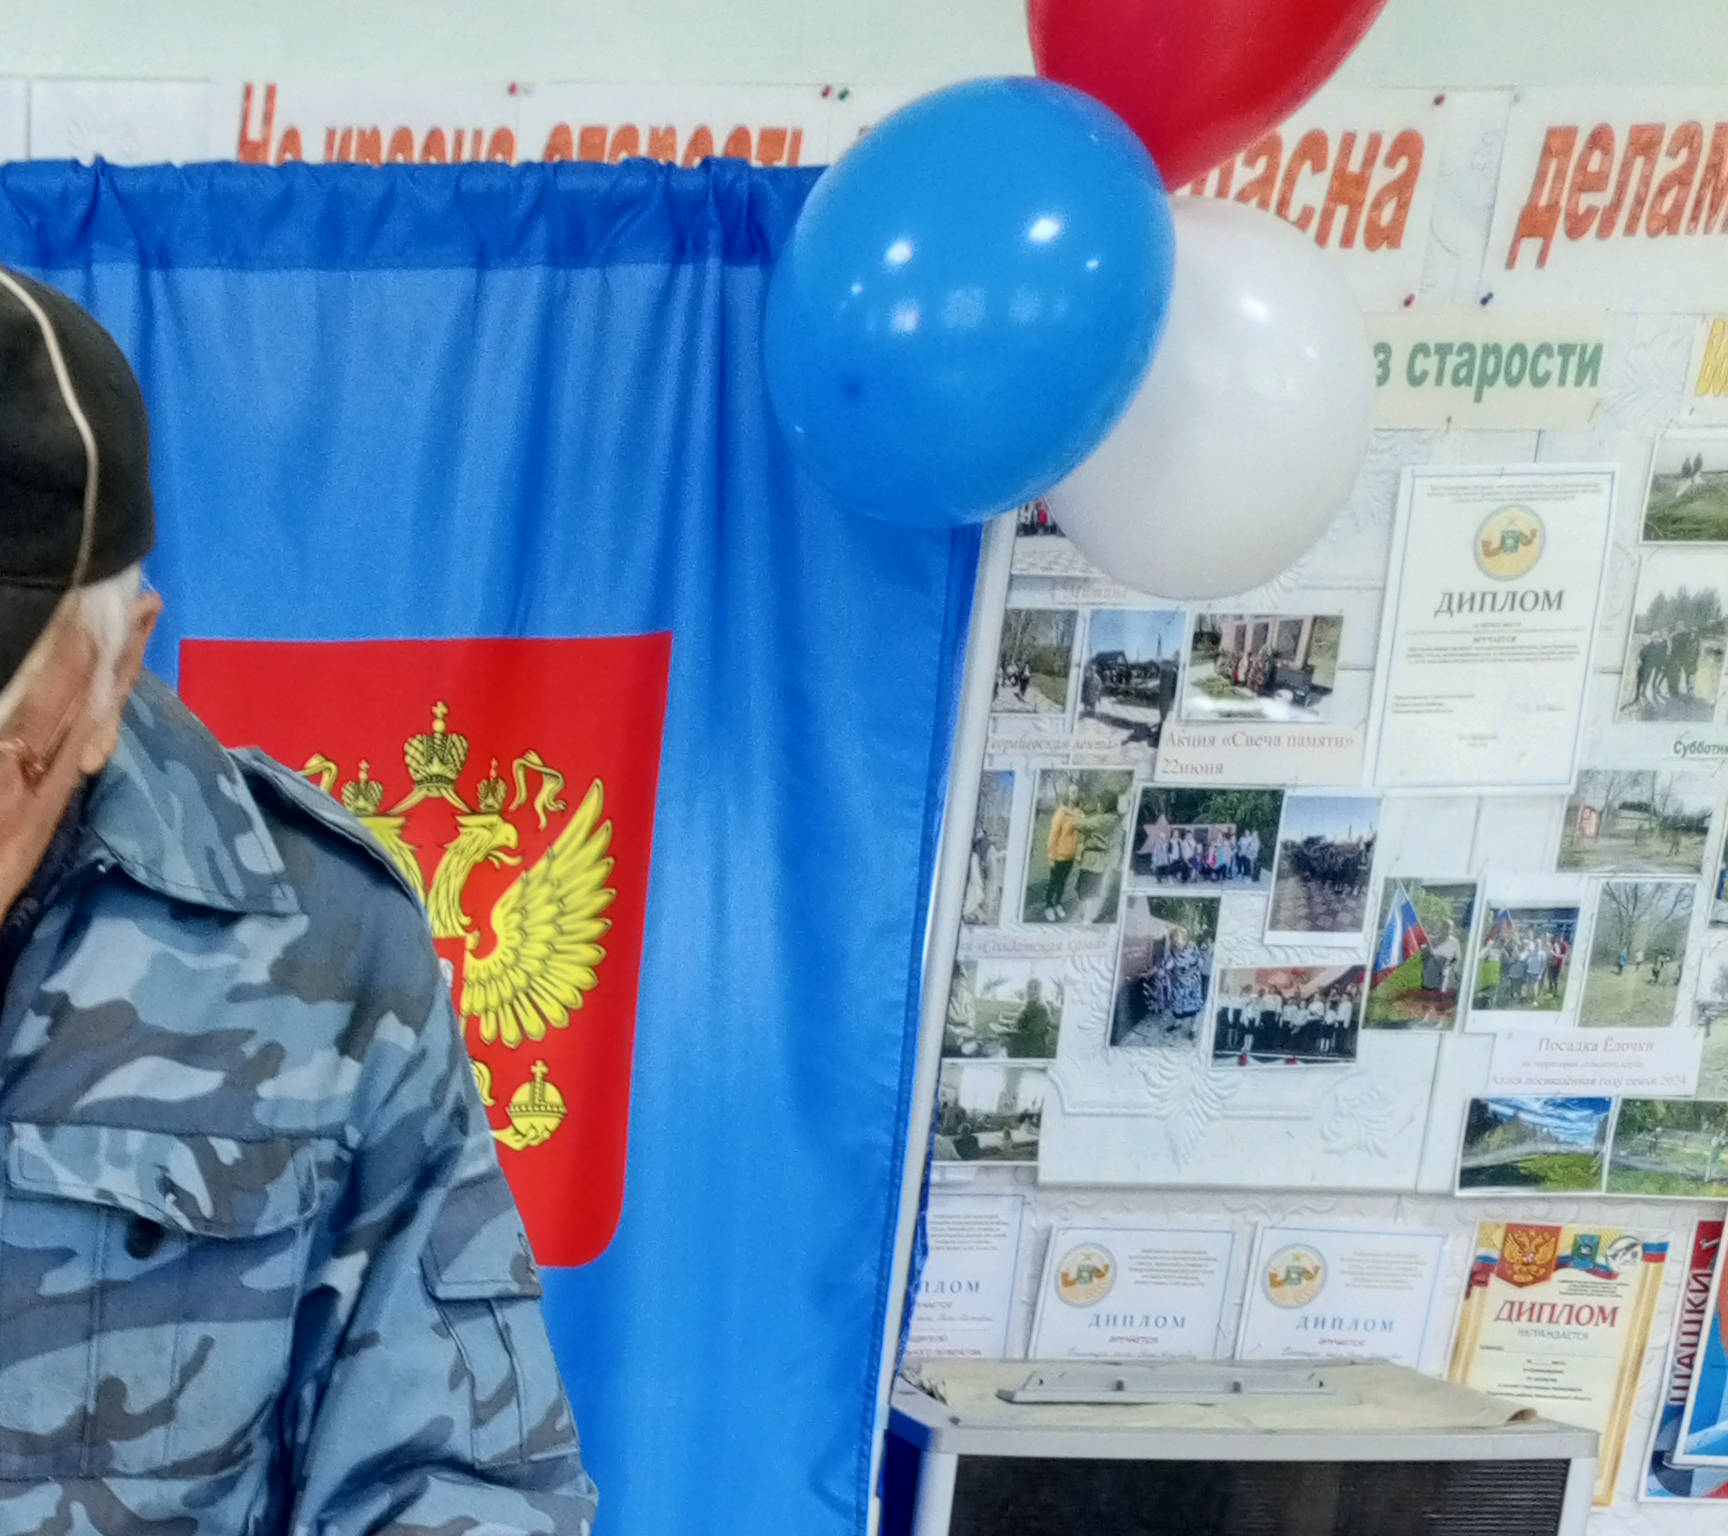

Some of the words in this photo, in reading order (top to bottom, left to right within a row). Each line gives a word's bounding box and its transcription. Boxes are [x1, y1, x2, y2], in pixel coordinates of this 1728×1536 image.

[1406, 341, 1604, 403] старости
[1434, 589, 1565, 618] ДИПЛОМ
[1166, 730, 1216, 750] Акция
[1222, 730, 1282, 750] «Свеча
[1287, 731, 1354, 749] памяти»
[1538, 1037, 1599, 1053] Посадка
[1088, 1313, 1187, 1329] ДИПЛОМ
[1295, 1315, 1396, 1333] ДИПЛОМ
[1492, 1299, 1621, 1328] ДИПЛОМ
[1669, 1268, 1713, 1405] ШАШКИ
